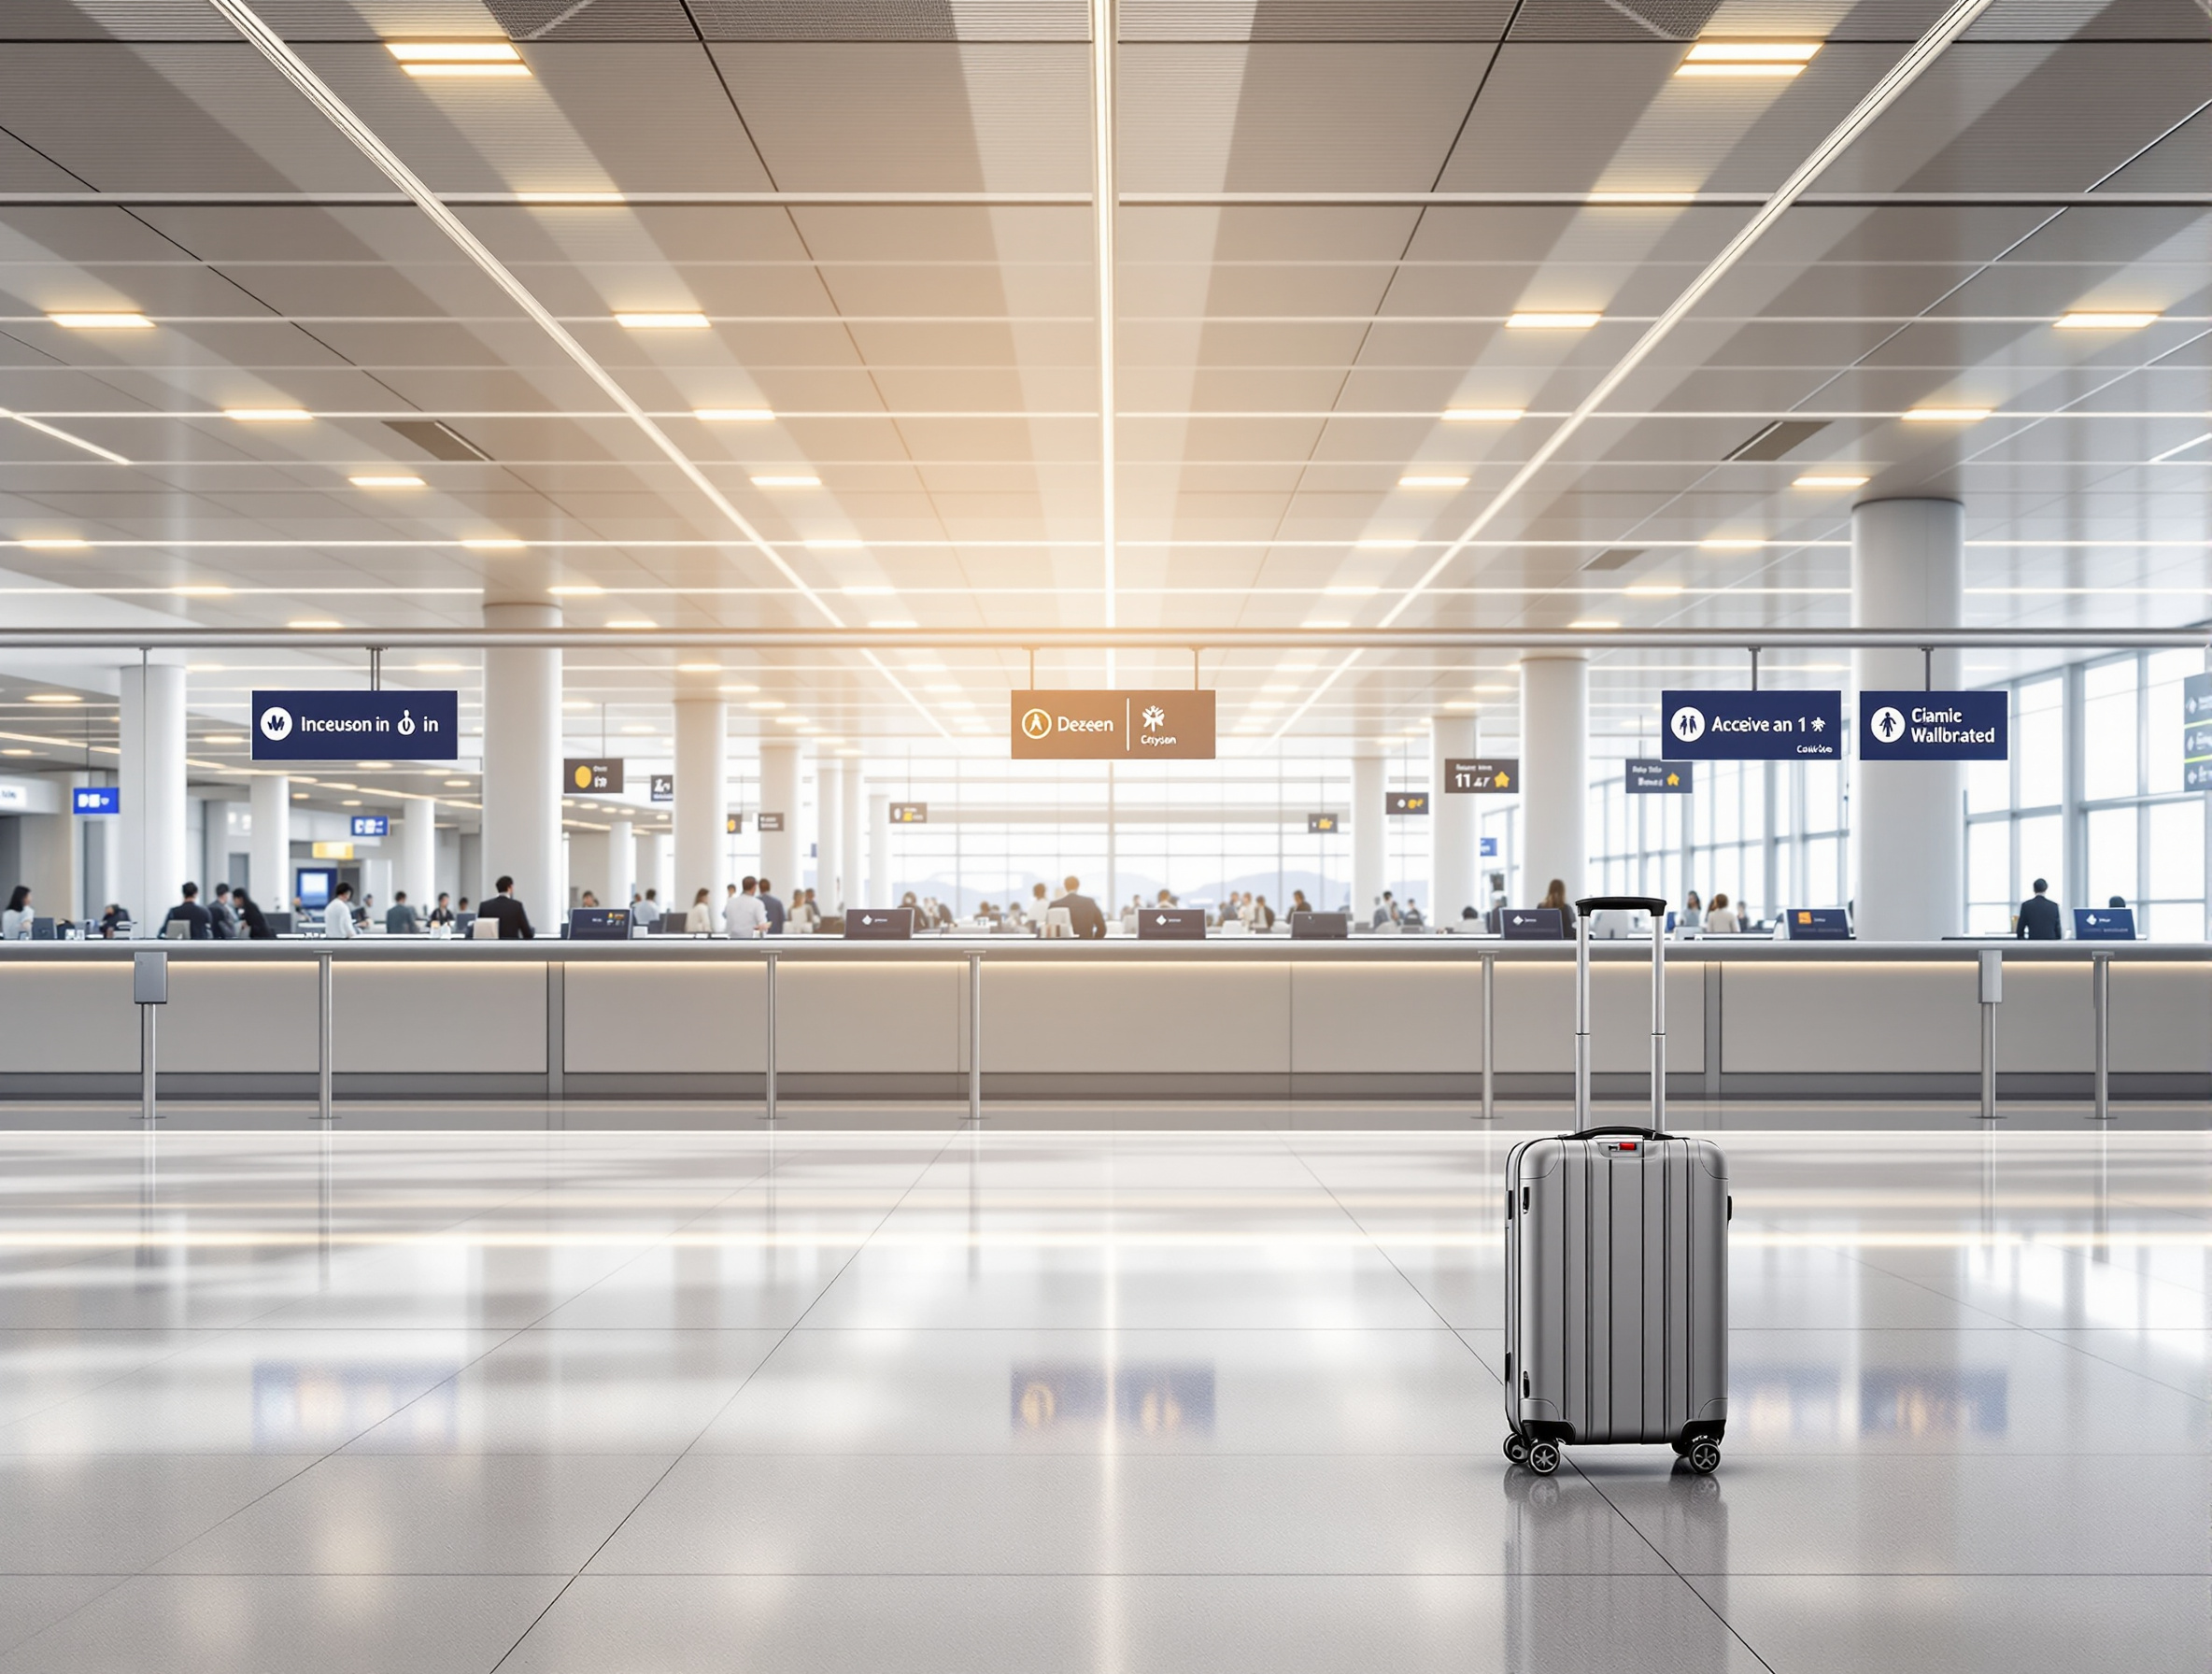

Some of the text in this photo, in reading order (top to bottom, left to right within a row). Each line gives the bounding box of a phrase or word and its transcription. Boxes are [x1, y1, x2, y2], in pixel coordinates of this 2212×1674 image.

[301, 716, 390, 732] Inceuson in
[423, 716, 439, 732] in
[1773, 719, 1794, 732] an
[1797, 716, 1807, 732] 1
[1910, 727, 1995, 744] Wallbrated
